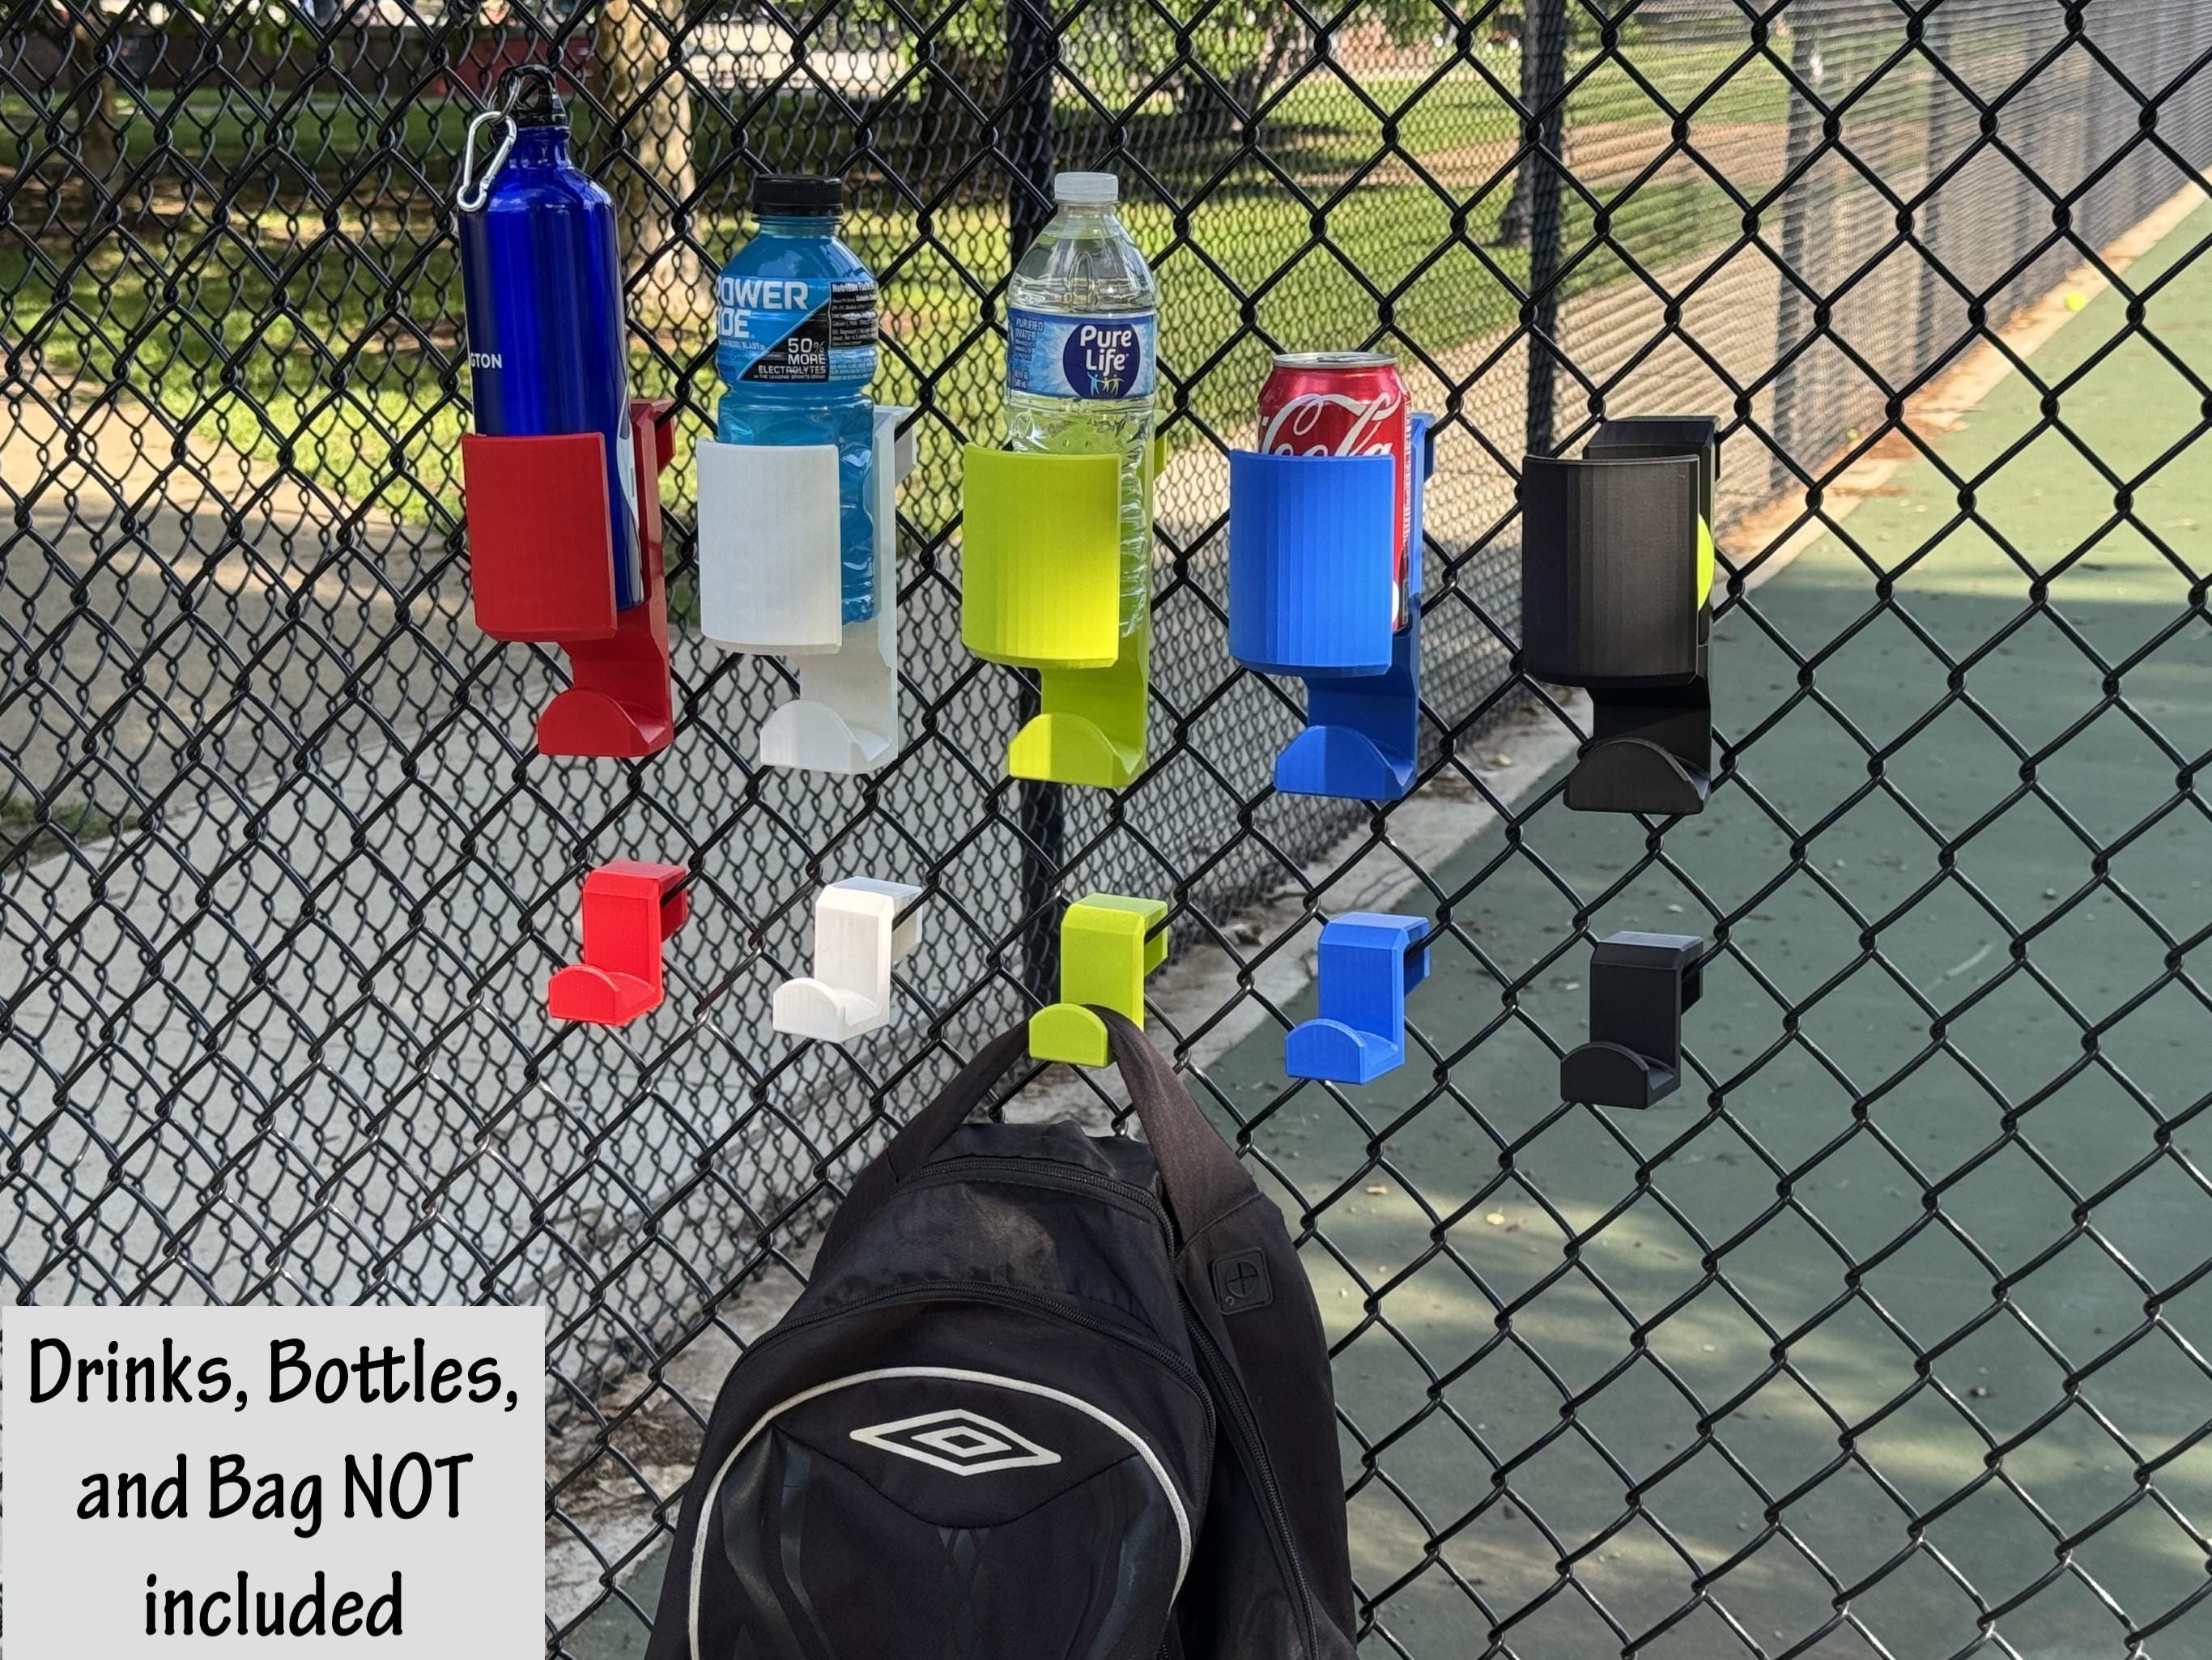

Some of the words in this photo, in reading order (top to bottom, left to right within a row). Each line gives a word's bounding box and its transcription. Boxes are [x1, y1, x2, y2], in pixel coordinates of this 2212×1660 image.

[1079, 325, 1132, 347] Pure
[788, 338, 826, 354] 50%
[788, 353, 827, 365] MORE
[1086, 348, 1125, 377] Life
[758, 365, 827, 375] ELECTROLYTES
